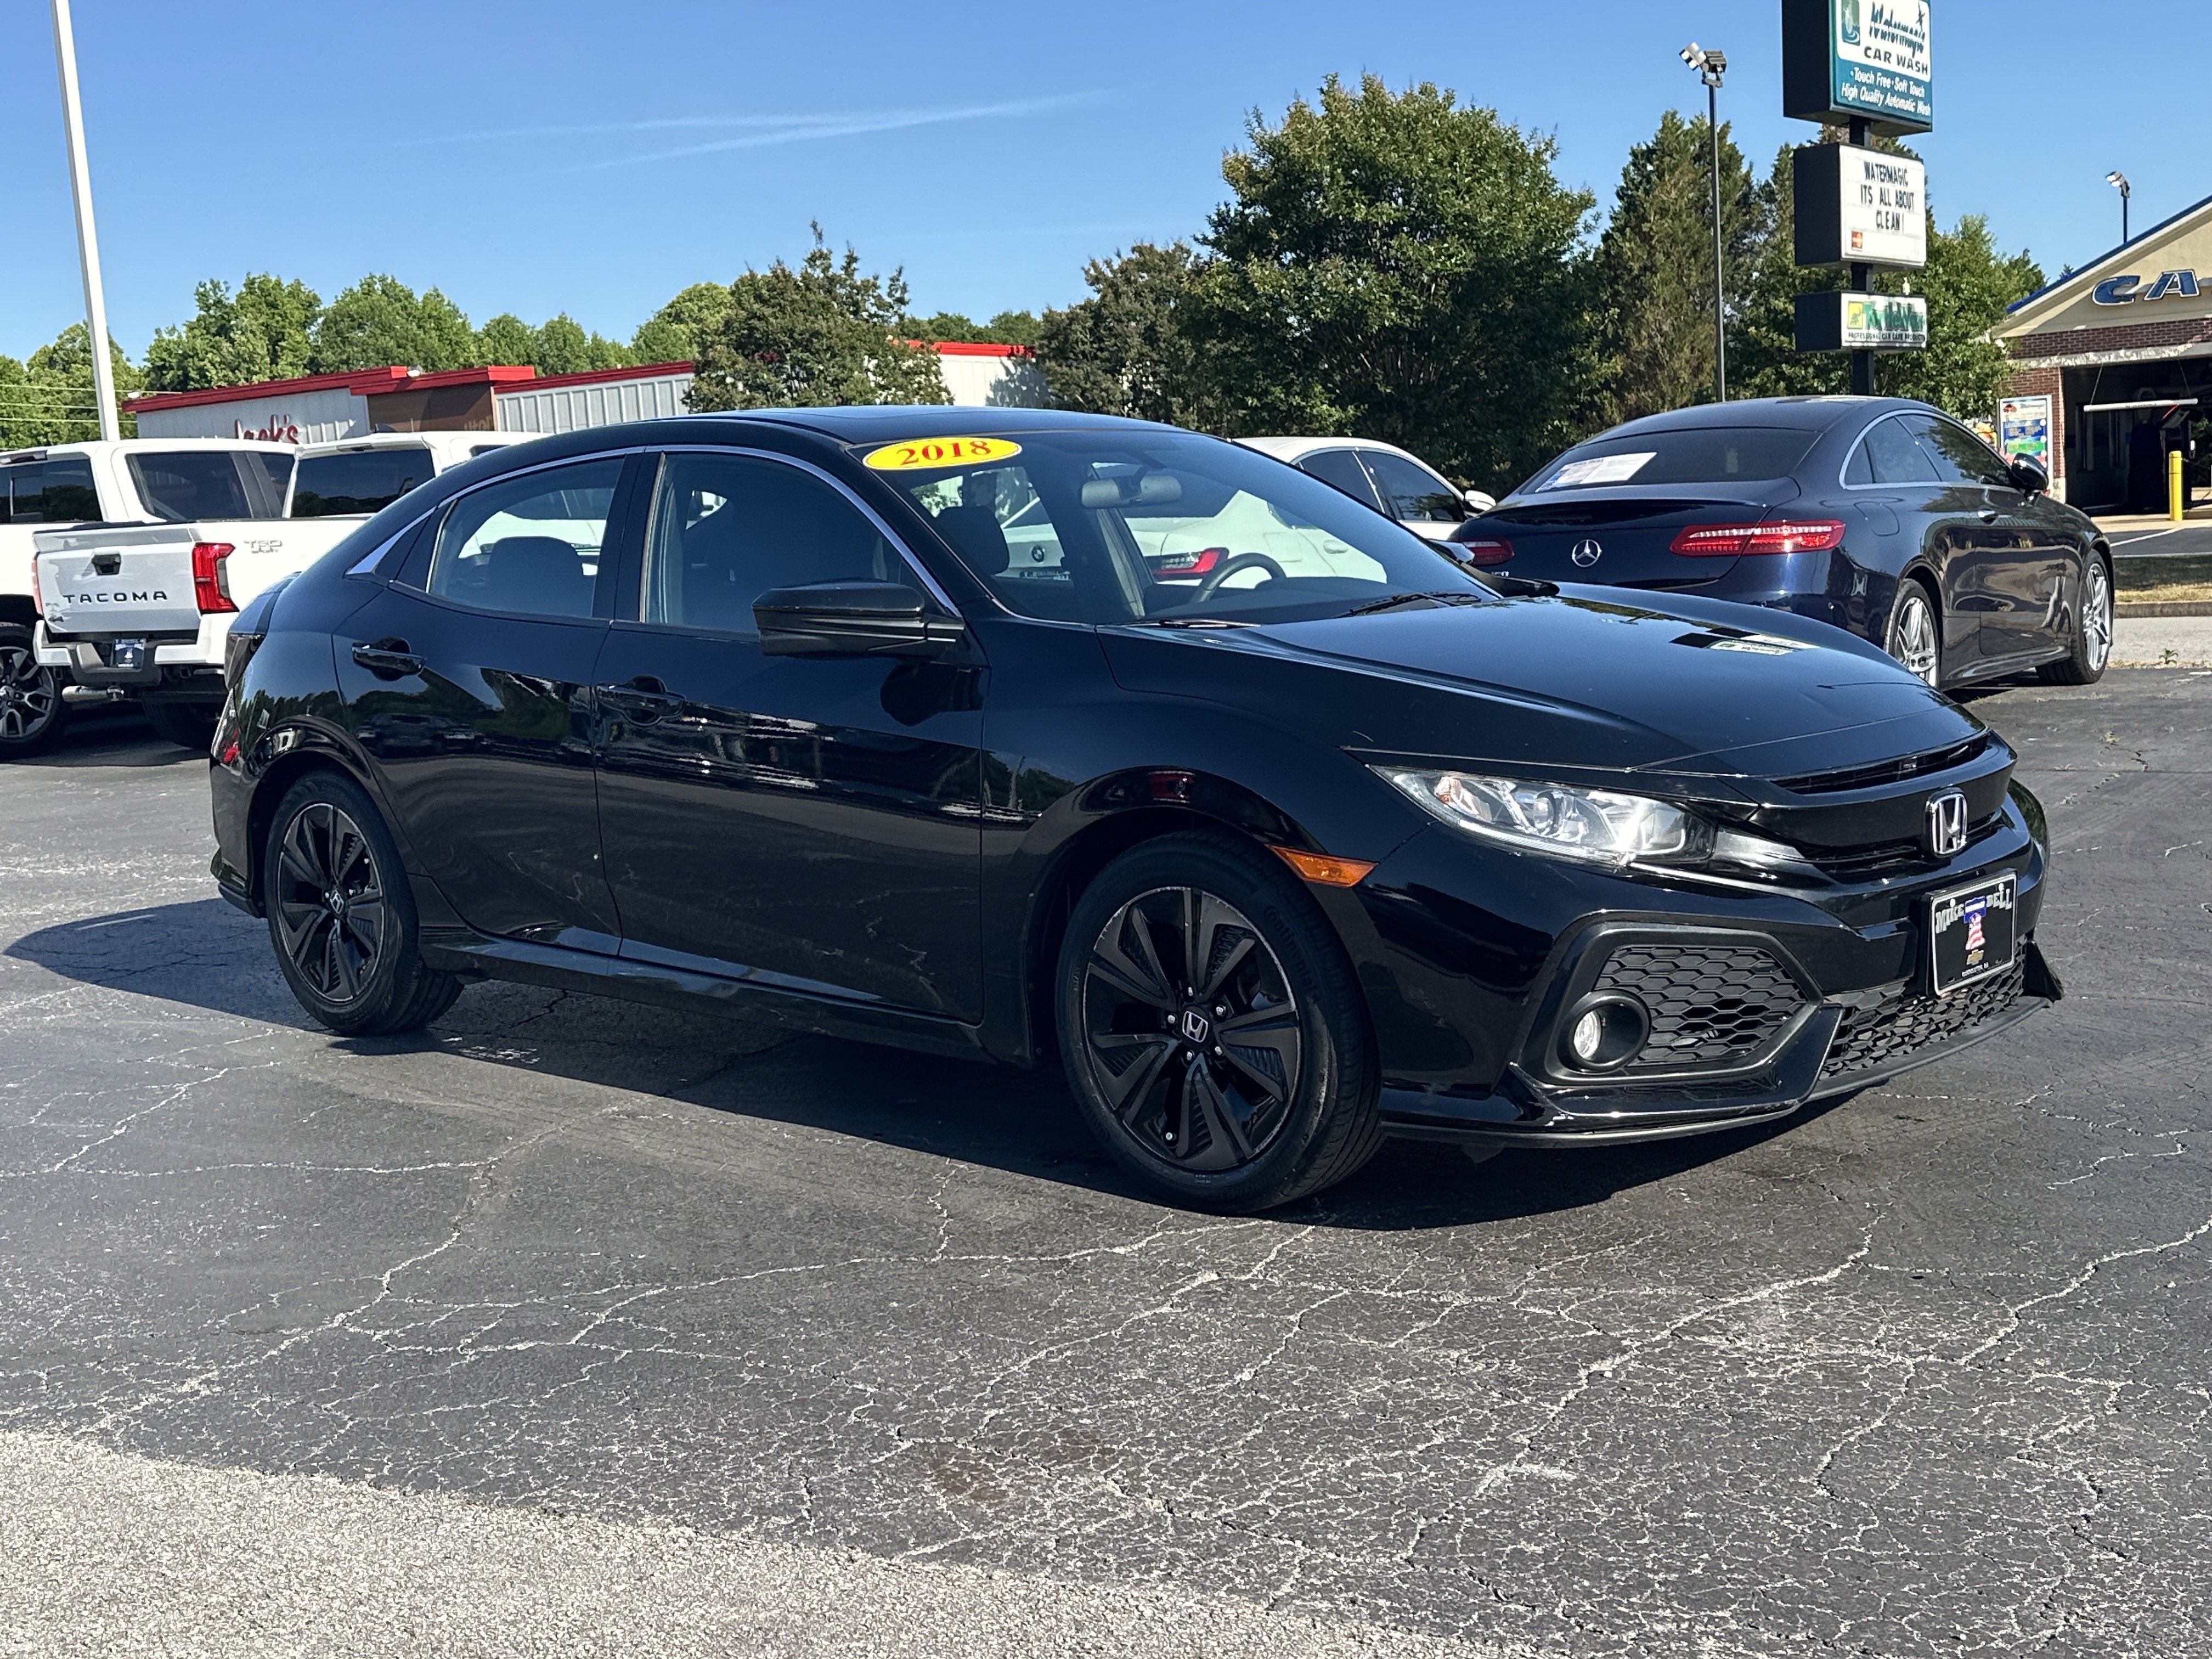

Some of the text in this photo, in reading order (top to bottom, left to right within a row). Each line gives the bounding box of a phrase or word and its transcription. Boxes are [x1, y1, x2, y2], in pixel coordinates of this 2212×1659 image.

[1864, 46, 1928, 75] CAR WASH
[1854, 67, 1874, 84] Touch
[1876, 72, 1891, 88] Free
[1894, 77, 1908, 93] Soft
[1841, 82, 1858, 101] High
[1860, 86, 1884, 107] Quality
[1864, 161, 1908, 187] WATERMAGIC
[1860, 184, 1915, 213] ITS ALL ABOUT
[896, 441, 991, 466] 2018
[62, 591, 167, 604] TACOMA
